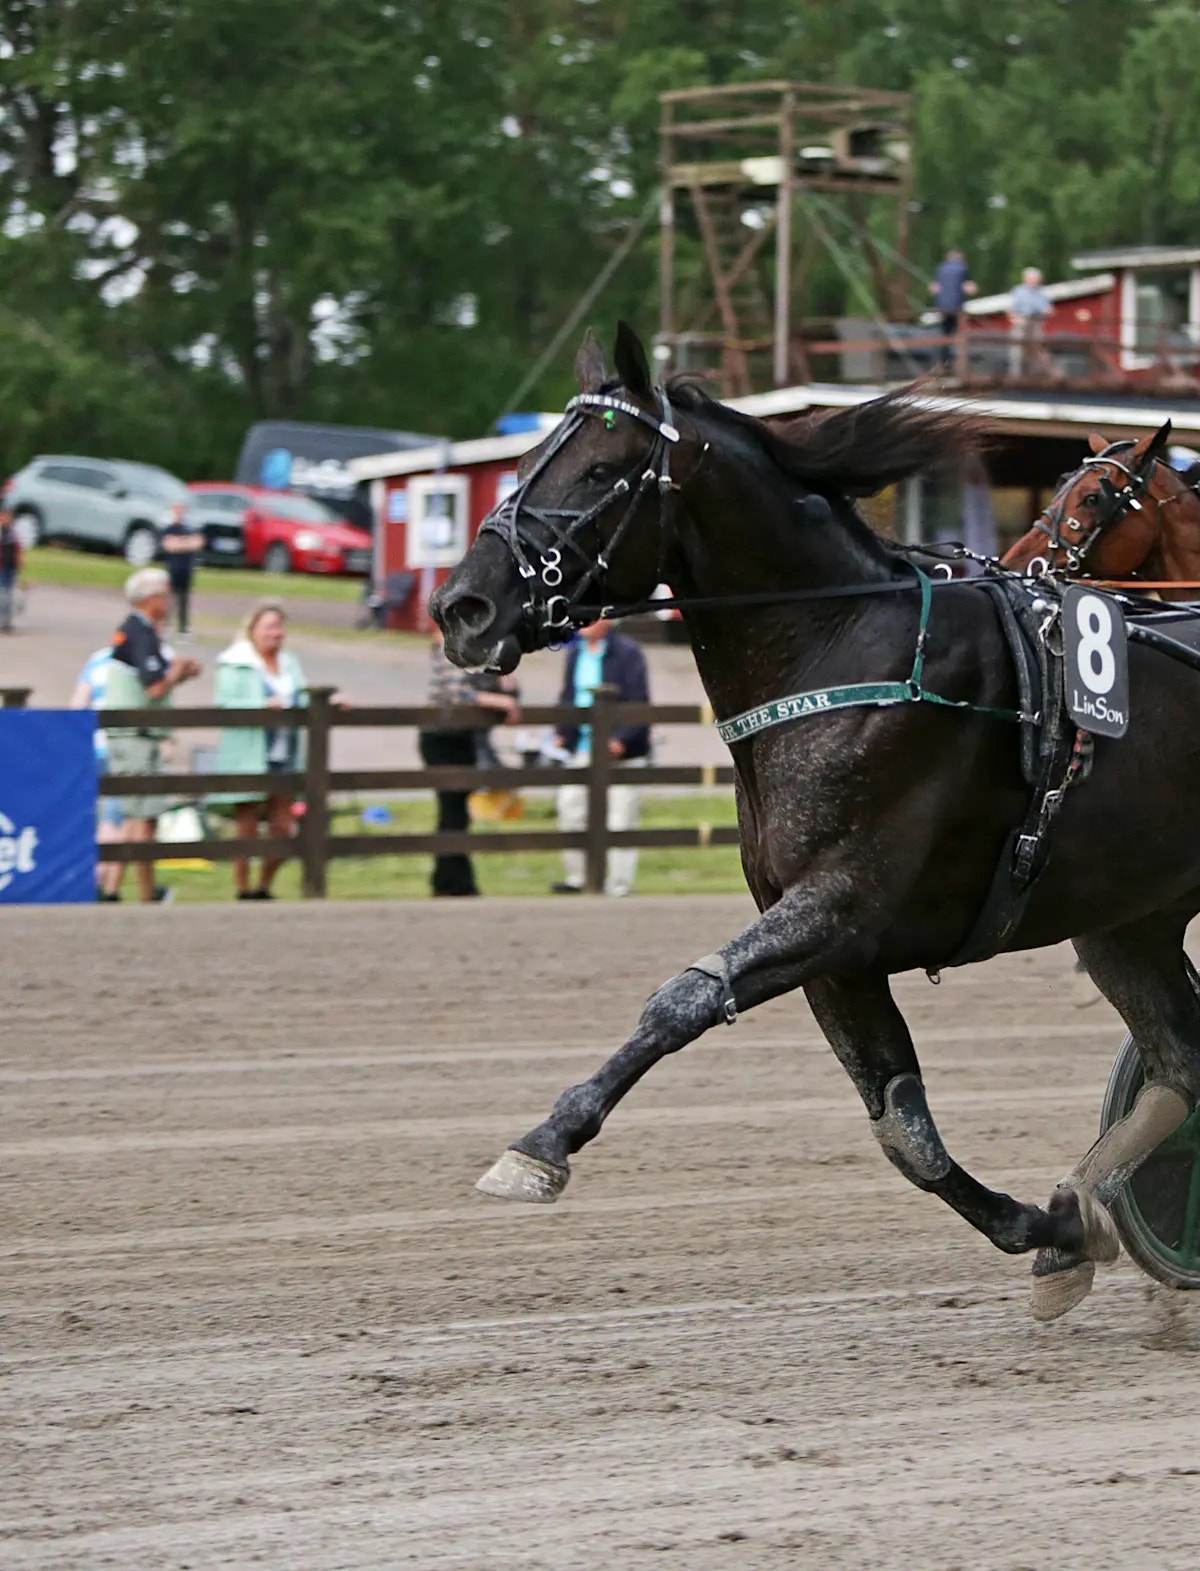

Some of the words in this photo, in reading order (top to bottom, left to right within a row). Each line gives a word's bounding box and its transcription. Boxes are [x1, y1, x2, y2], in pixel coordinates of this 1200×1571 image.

[1076, 595, 1115, 694] 8
[737, 708, 772, 733] THE
[776, 693, 832, 720] STAR
[1072, 690, 1124, 725] LinSon
